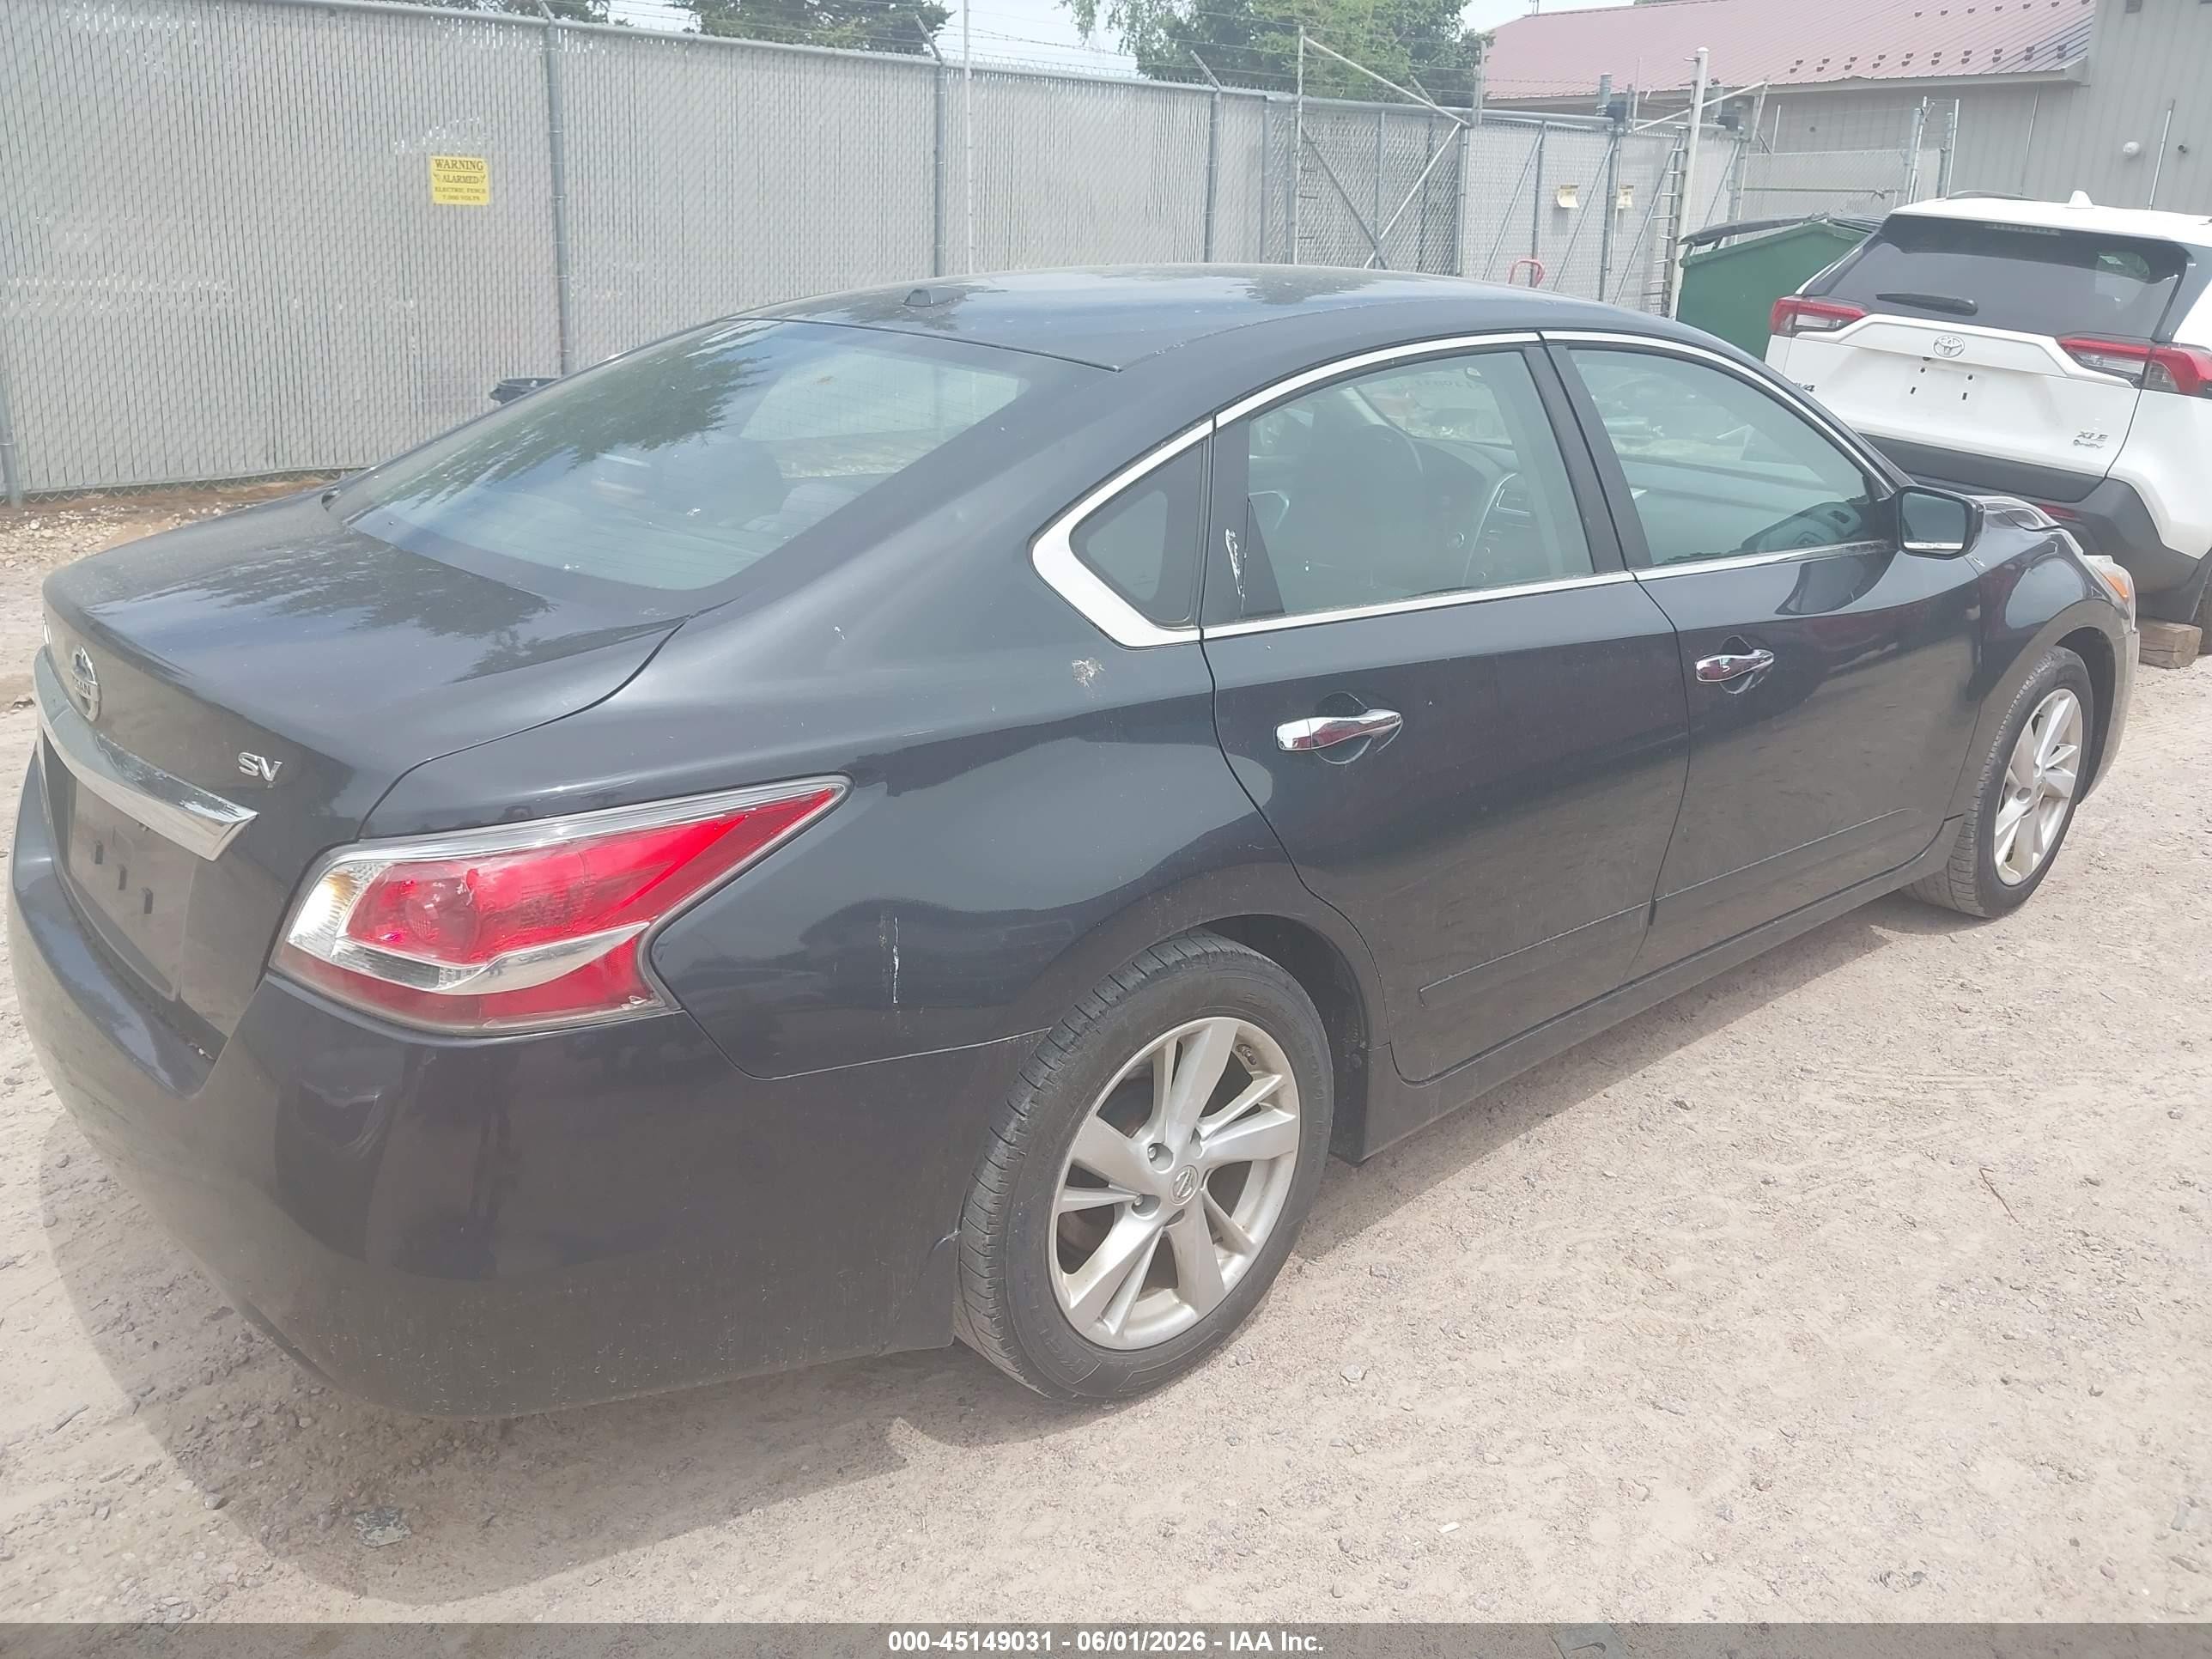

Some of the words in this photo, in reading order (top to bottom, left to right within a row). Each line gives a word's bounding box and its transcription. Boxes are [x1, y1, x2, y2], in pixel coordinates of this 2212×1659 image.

[434, 159, 483, 171] WARNING
[442, 174, 479, 184] ALARMED
[238, 751, 283, 781] SV
